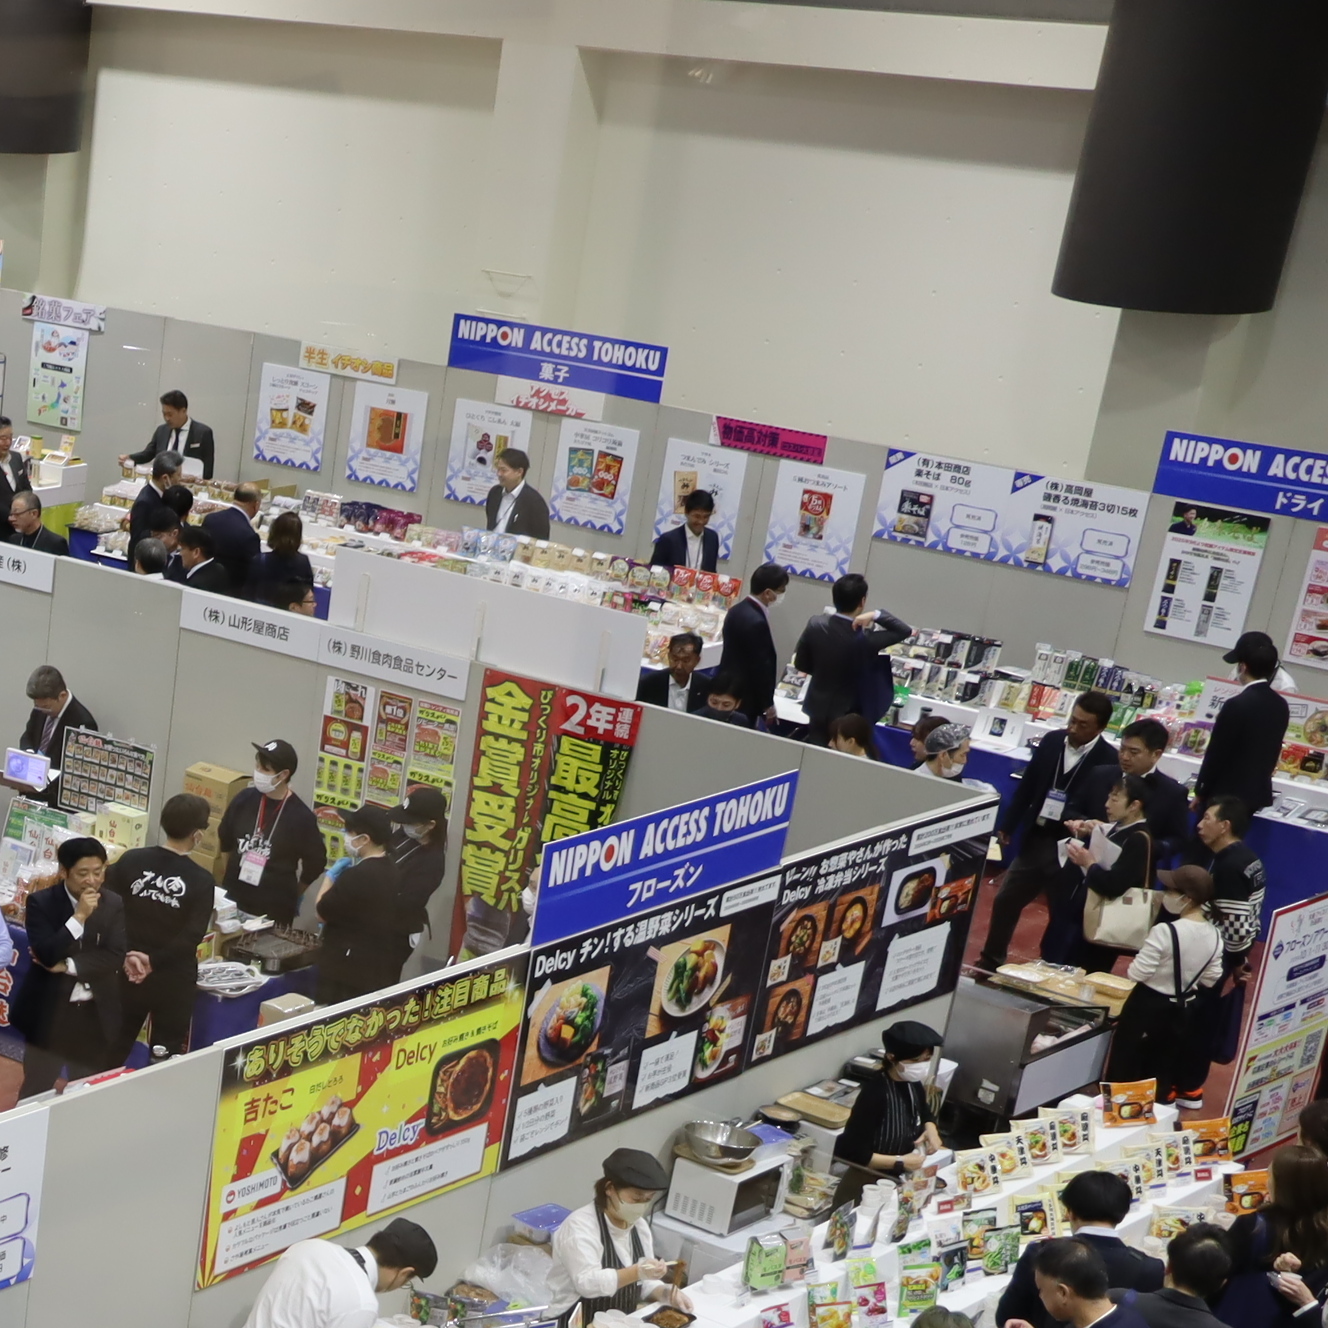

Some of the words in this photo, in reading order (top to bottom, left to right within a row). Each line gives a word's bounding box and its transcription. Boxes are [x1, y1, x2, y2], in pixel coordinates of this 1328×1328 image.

[31, 298, 96, 326] 銘菓フェア
[304, 345, 328, 366] 半生
[458, 318, 525, 349] NIPPON
[530, 331, 588, 359] ACCESS
[593, 340, 662, 371] TOHOKU
[539, 361, 570, 383] 菓子
[722, 422, 780, 449] 物価高対策
[916, 457, 971, 476] (有)本田商店
[1168, 437, 1262, 474] NIPPON
[1045, 480, 1093, 498] (株)高岡屋
[1275, 491, 1325, 516] ドライ
[202, 605, 290, 643] (株)山形屋商店
[327, 638, 458, 682] (株)野川食肉食品センター
[559, 694, 614, 736] 2年
[460, 681, 531, 910] 金賞受賞
[548, 826, 634, 888] NIPPON
[641, 802, 709, 860] ACCESS
[711, 781, 790, 838] TOHOKU
[626, 863, 704, 909] フローズン
[781, 885, 810, 906] Delcy
[534, 949, 576, 978] Delcy
[395, 1037, 438, 1071] Delcy
[243, 1087, 295, 1125] 吉たこ
[375, 1121, 420, 1154] Delcy
[236, 1174, 278, 1200] YOSHIMOTO
